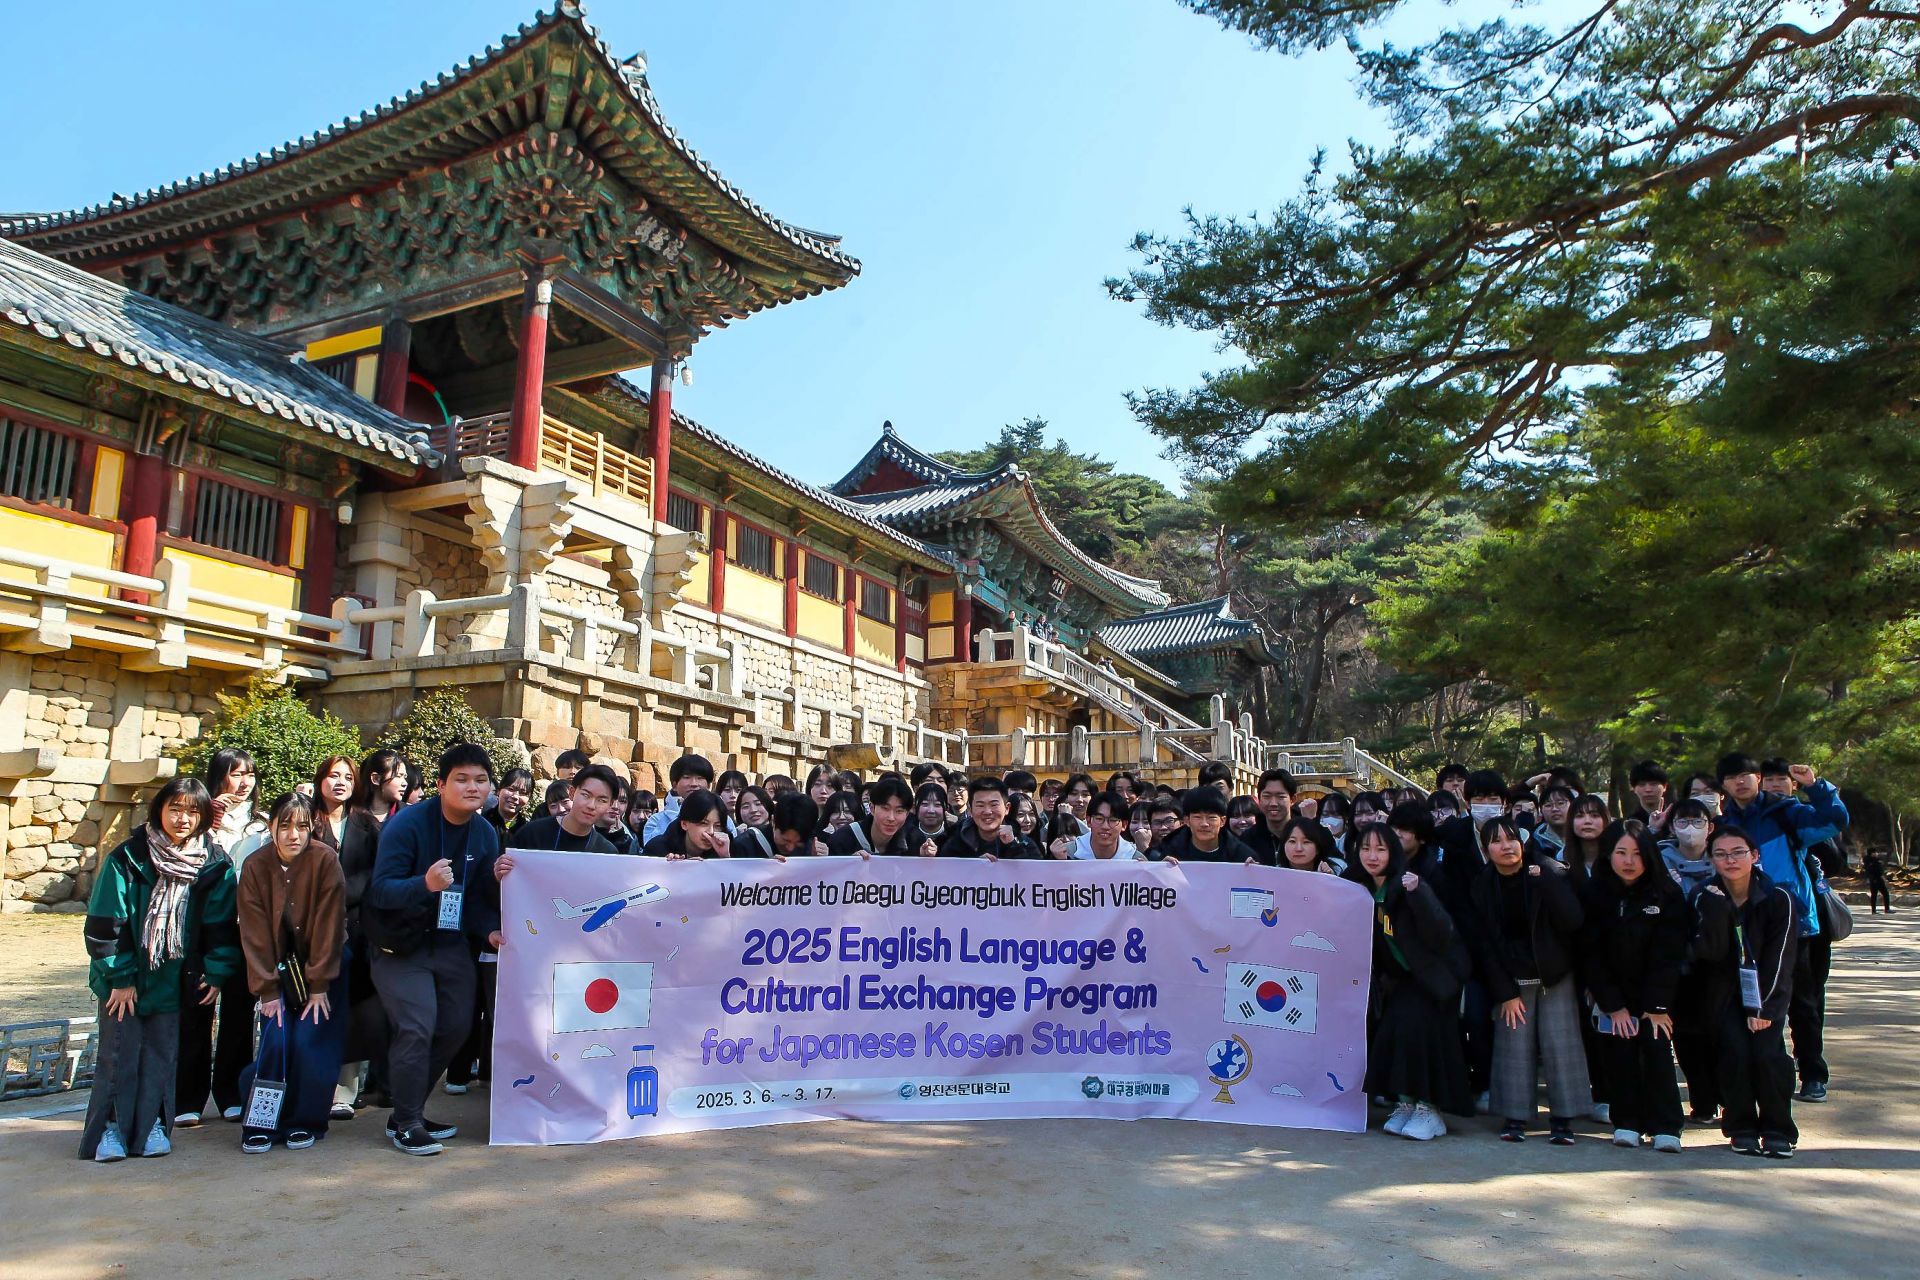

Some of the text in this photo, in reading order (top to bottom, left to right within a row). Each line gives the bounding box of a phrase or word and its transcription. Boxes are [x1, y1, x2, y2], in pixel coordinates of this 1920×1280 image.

[720, 880, 1177, 911] Welcome to Daegu Gyeongbuk English Village
[741, 926, 1147, 972] 2025 English Language &
[720, 974, 1158, 1018] Cultural Exchange Program
[701, 1019, 1172, 1068] for Japanese Kosen Students
[696, 1092, 738, 1109] 2025.
[742, 1090, 756, 1105] 3.
[761, 1089, 775, 1103] 6.
[794, 1088, 808, 1101] 3.
[815, 1087, 836, 1100] 17.
[919, 1082, 1011, 1097] 영진전문대학교
